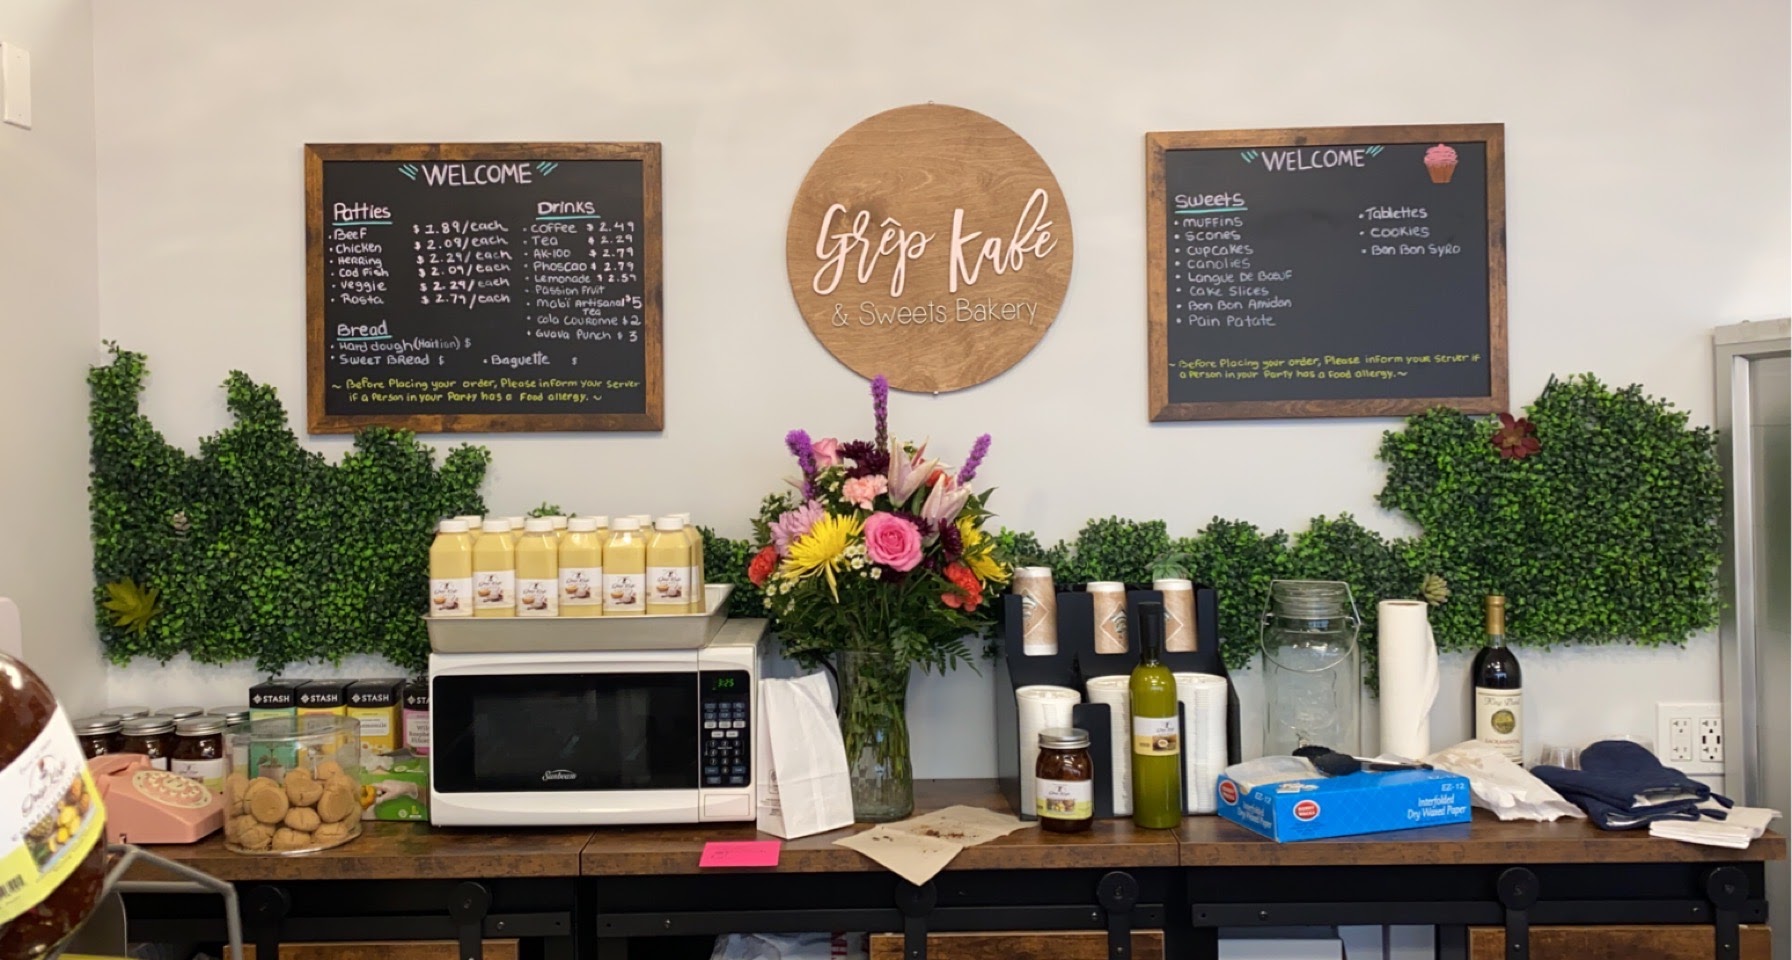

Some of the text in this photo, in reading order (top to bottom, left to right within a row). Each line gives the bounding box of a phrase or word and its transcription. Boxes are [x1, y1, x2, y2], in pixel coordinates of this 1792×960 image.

[1261, 148, 1365, 172] WELCOME
[421, 163, 532, 187] WELCOME
[333, 202, 391, 221] Patties
[1365, 206, 1428, 220] Tablettes
[599, 221, 634, 232] 2.49
[531, 236, 558, 246] Tea
[601, 234, 632, 244] 2.29
[813, 188, 1058, 298] Grêp Kafé
[602, 247, 633, 258] 2.79
[1371, 244, 1396, 255] Bon
[1400, 244, 1425, 255] Bon
[604, 262, 634, 271] 2.79
[534, 275, 590, 283] Lemonade
[1188, 272, 1235, 285] Langue
[535, 285, 606, 295] Passion Fruit
[1188, 296, 1292, 311] Bon Bon Amidon
[831, 297, 1038, 327] & Sweets Bakery
[1188, 314, 1277, 327] Pain Patate
[337, 319, 388, 337] Bread
[576, 329, 611, 341] Punch
[629, 330, 638, 342] 3
[464, 337, 472, 348] $
[439, 355, 445, 366] $
[491, 350, 578, 369] Baguette $
[1262, 360, 1285, 370] your
[1236, 371, 1259, 380] your
[1296, 370, 1315, 378] has
[431, 379, 457, 390] your
[580, 379, 603, 389] your
[406, 393, 417, 402] in
[419, 393, 443, 403] your
[480, 392, 503, 402] has
[263, 695, 290, 703] STASH
[310, 694, 338, 703] STASH
[361, 693, 389, 703] STASH
[1418, 793, 1455, 808] Interfolded
[1407, 805, 1467, 821] Dry Waxed Paper
